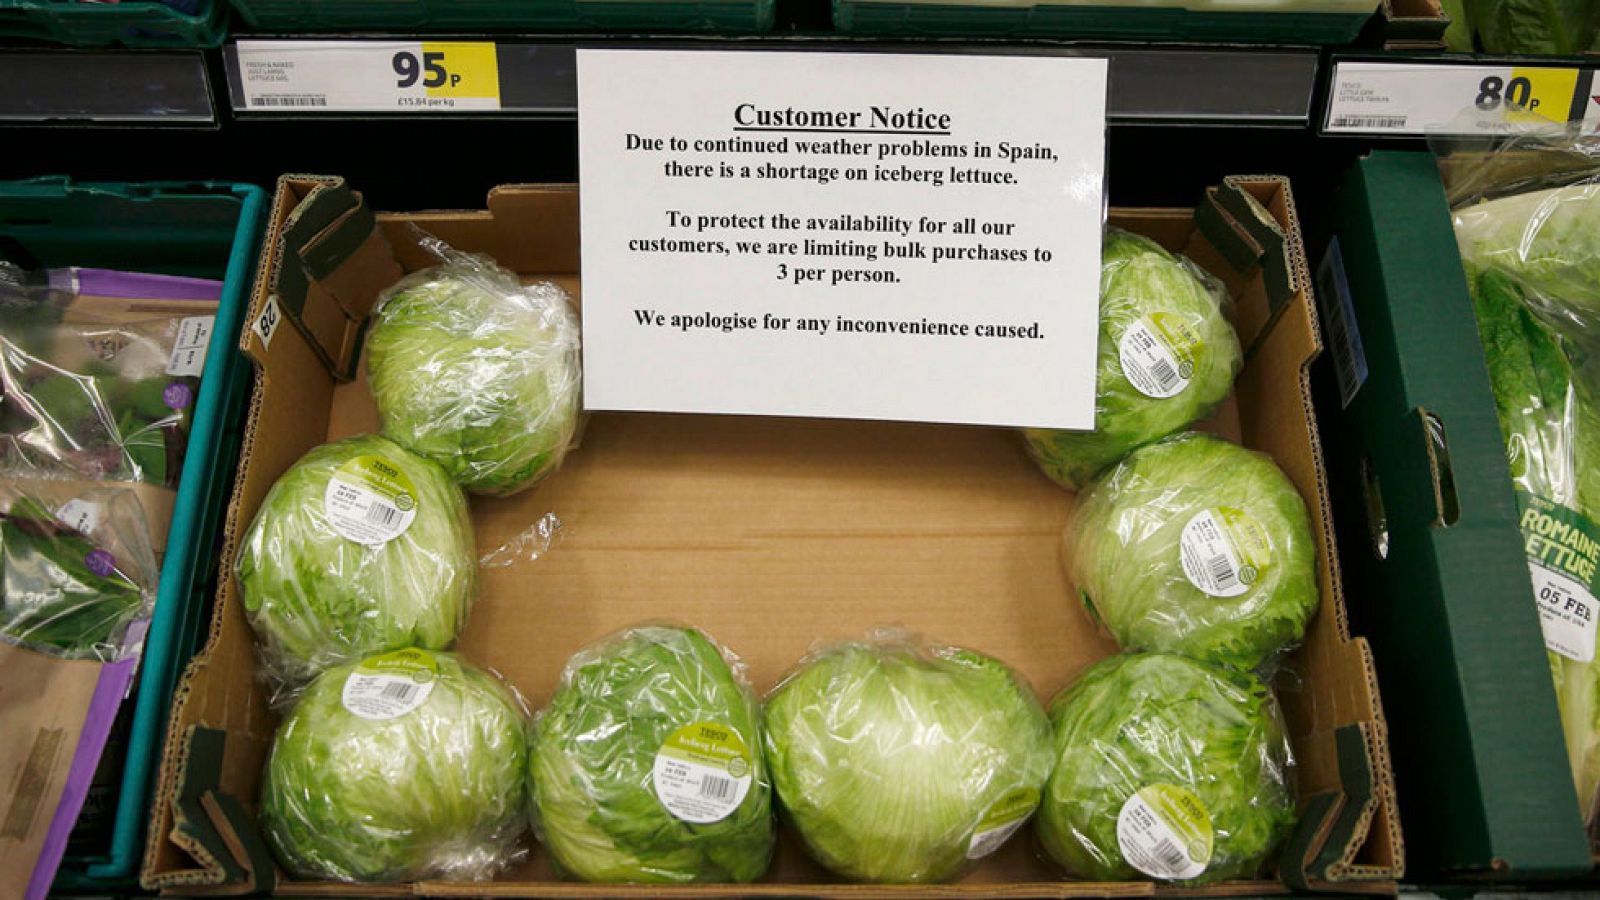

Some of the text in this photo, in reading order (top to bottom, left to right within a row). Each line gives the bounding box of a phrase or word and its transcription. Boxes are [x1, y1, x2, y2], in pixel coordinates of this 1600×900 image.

[428, 99, 442, 107] per
[443, 98, 455, 107] kg
[733, 104, 952, 131] Customer Notice
[625, 134, 1059, 165] Due to continued weather problems in Spain,
[663, 160, 1019, 188] there is a shortage on iceberg lettuce.
[665, 211, 1016, 238] To protect the availability for all our
[628, 237, 1053, 265] customers, we are limiting bulk purchases to
[776, 264, 901, 287] 3 per person.
[260, 302, 276, 337] 28
[633, 310, 1045, 340] We apologise for any inconvenience caused.
[1520, 508, 1600, 565] ROMAINE
[1521, 530, 1596, 584] ETTUCE
[1540, 587, 1561, 605] 05
